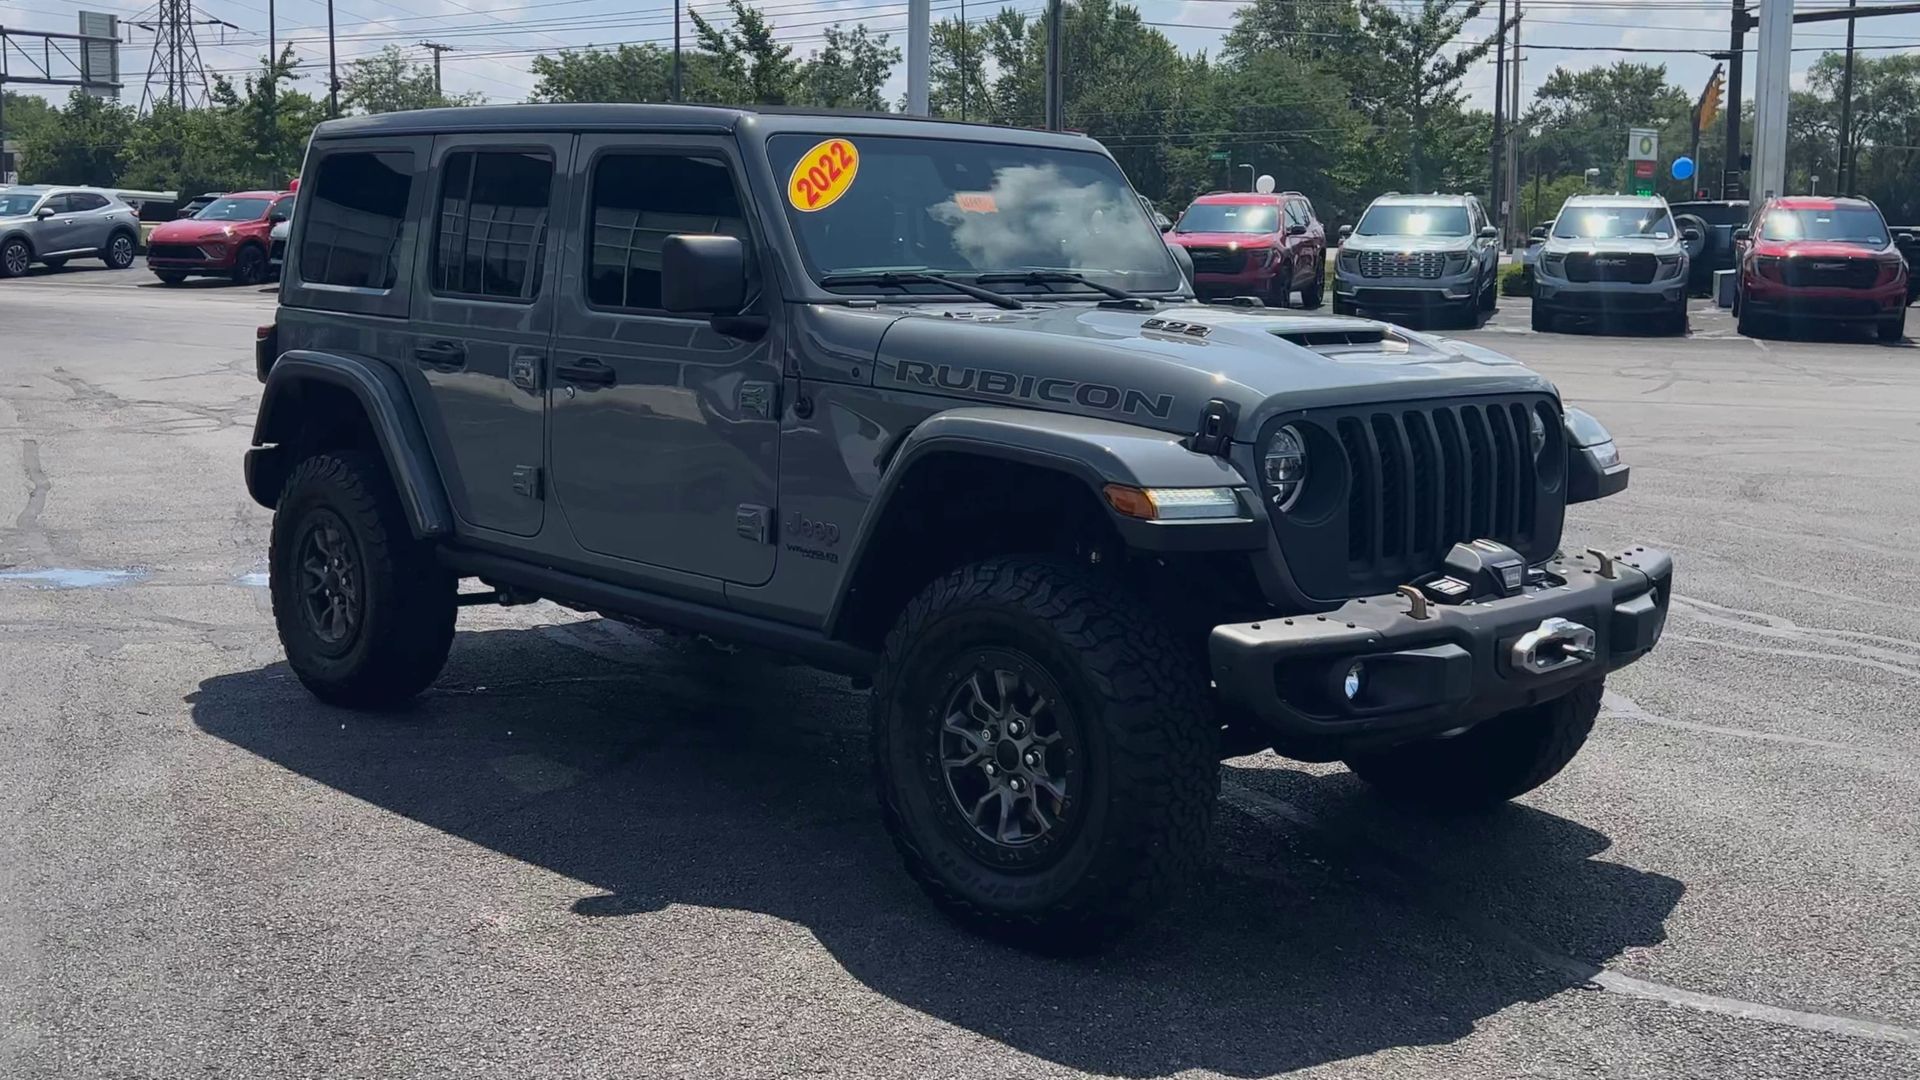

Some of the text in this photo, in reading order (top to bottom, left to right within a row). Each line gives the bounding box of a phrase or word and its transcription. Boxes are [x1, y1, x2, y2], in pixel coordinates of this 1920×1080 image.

[797, 142, 854, 207] 2022
[894, 359, 1176, 420] RUBICON
[786, 511, 840, 547] Jeep
